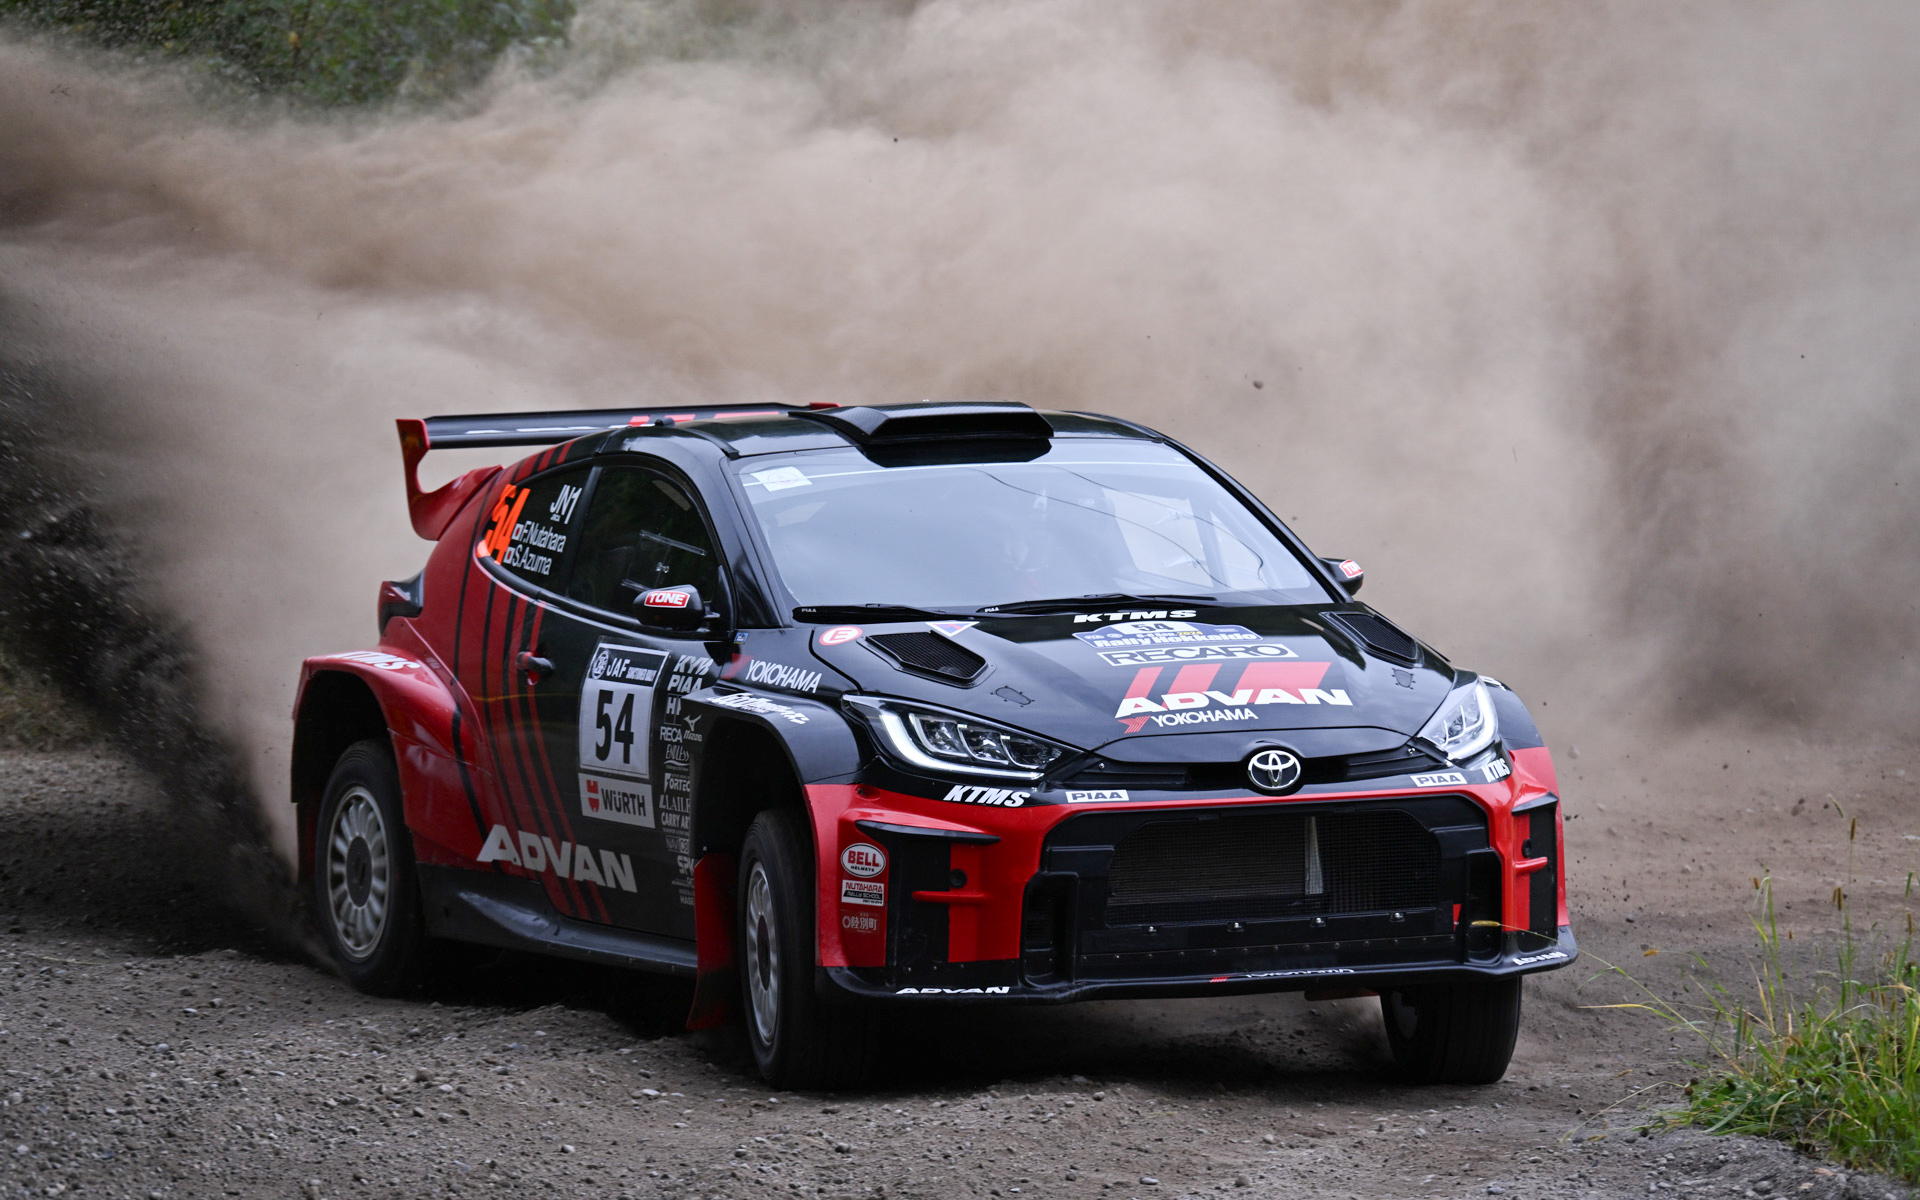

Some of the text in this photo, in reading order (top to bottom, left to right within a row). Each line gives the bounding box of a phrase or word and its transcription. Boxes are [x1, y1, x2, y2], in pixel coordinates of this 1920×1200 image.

[550, 484, 582, 525] JN1
[520, 520, 567, 553] F.Nutahara
[512, 543, 552, 576] S.Azuma
[649, 592, 686, 606] TONE
[1073, 610, 1197, 624] KTMS
[1131, 622, 1174, 632] 54
[1093, 637, 1152, 648] Rally
[1150, 632, 1258, 646] Hokkaido
[673, 654, 714, 676] KYB
[1102, 644, 1289, 665] RECARO
[606, 657, 631, 678] JAF
[745, 658, 822, 694] YOKOHAMA
[667, 674, 703, 694] PIAA
[1115, 687, 1353, 718] ADVAN
[595, 688, 635, 765] 54
[1150, 707, 1259, 728] YOKOHAMA
[1415, 773, 1464, 785] PIAA
[1481, 757, 1511, 783] KTMS
[600, 787, 647, 817] WÜRTH
[943, 784, 1031, 807] KTMS
[1071, 790, 1124, 801] PIAA
[476, 823, 638, 894] ADVAN
[847, 850, 880, 867] BELL
[845, 881, 883, 893] NUTAHARA
[895, 985, 1010, 994] ADVAN
